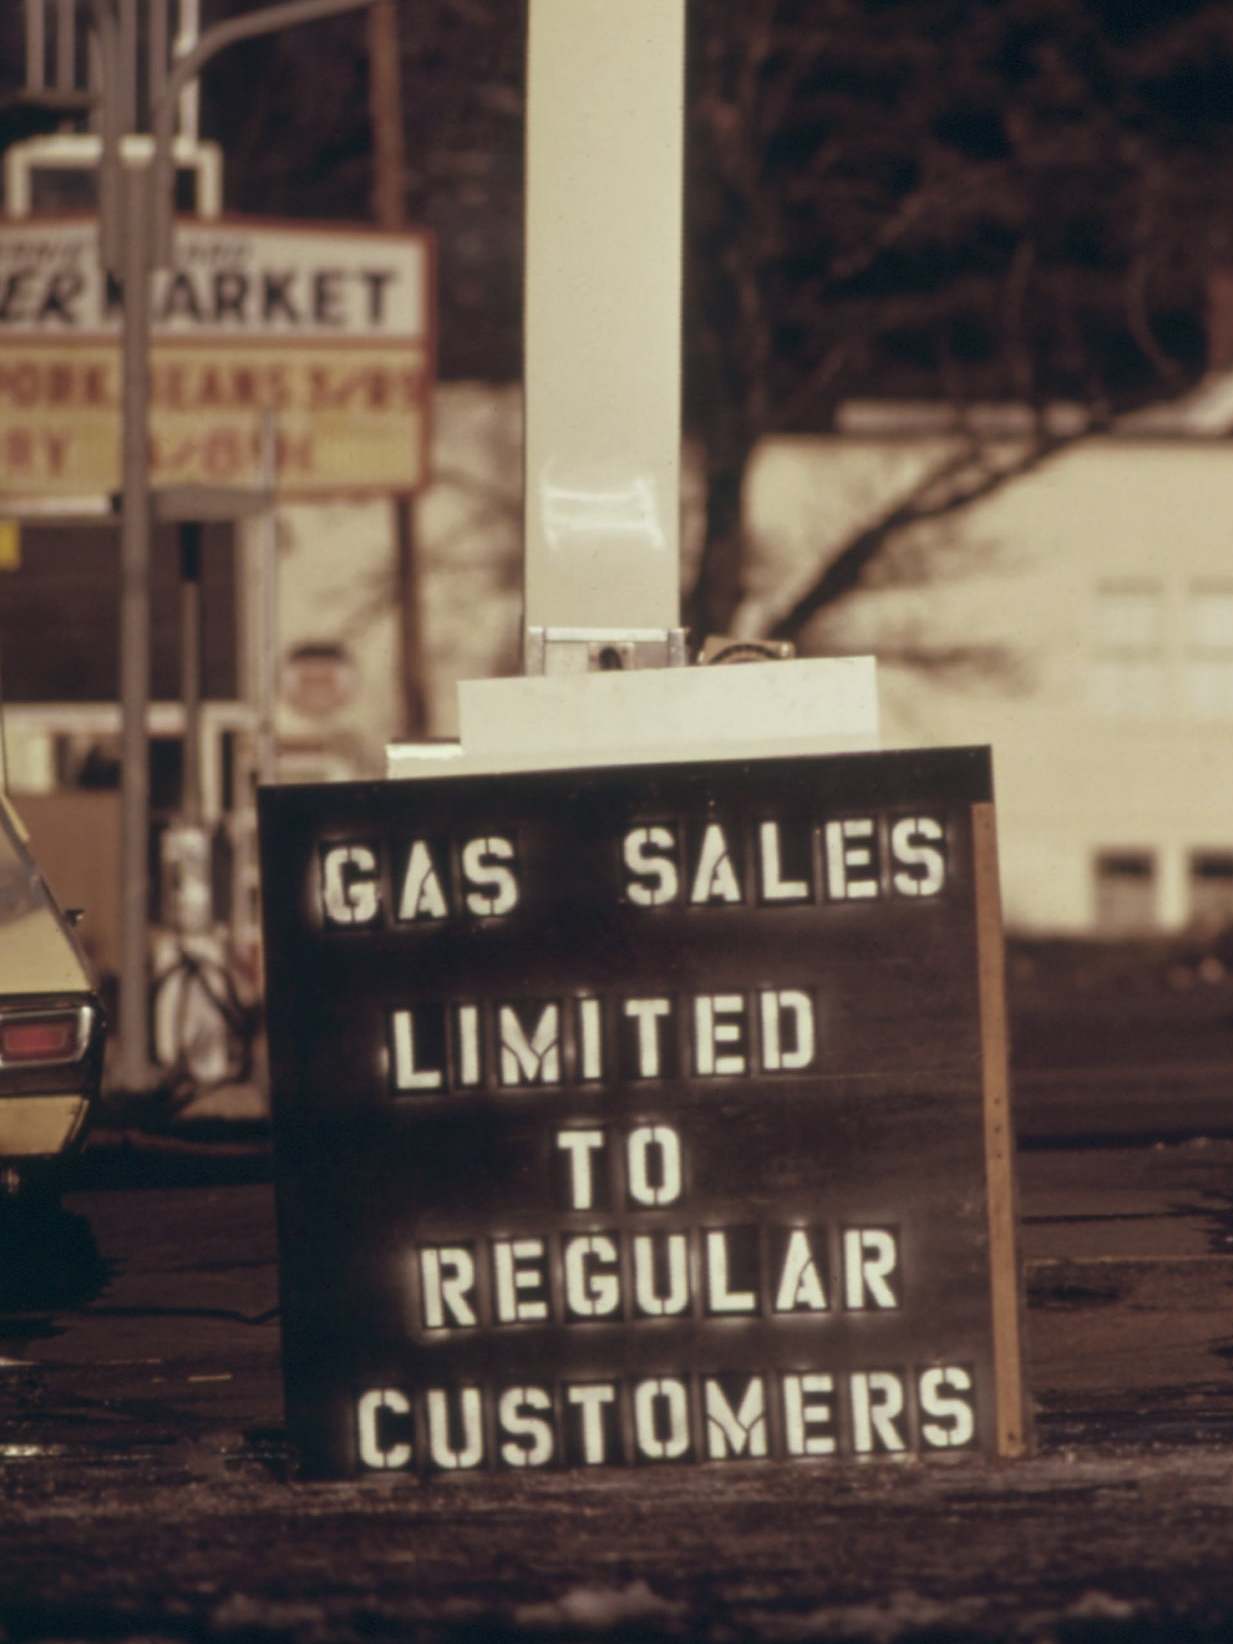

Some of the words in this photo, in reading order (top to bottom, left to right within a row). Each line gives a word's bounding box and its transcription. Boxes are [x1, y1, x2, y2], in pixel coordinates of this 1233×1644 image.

[146, 363, 292, 410] EANS
[321, 837, 519, 924] GAS
[623, 817, 946, 906] SALES
[392, 990, 815, 1090] LIMITED
[557, 1125, 682, 1210] TO
[420, 1228, 897, 1328] REGULAR
[357, 1366, 975, 1468] CUSTOMERS
